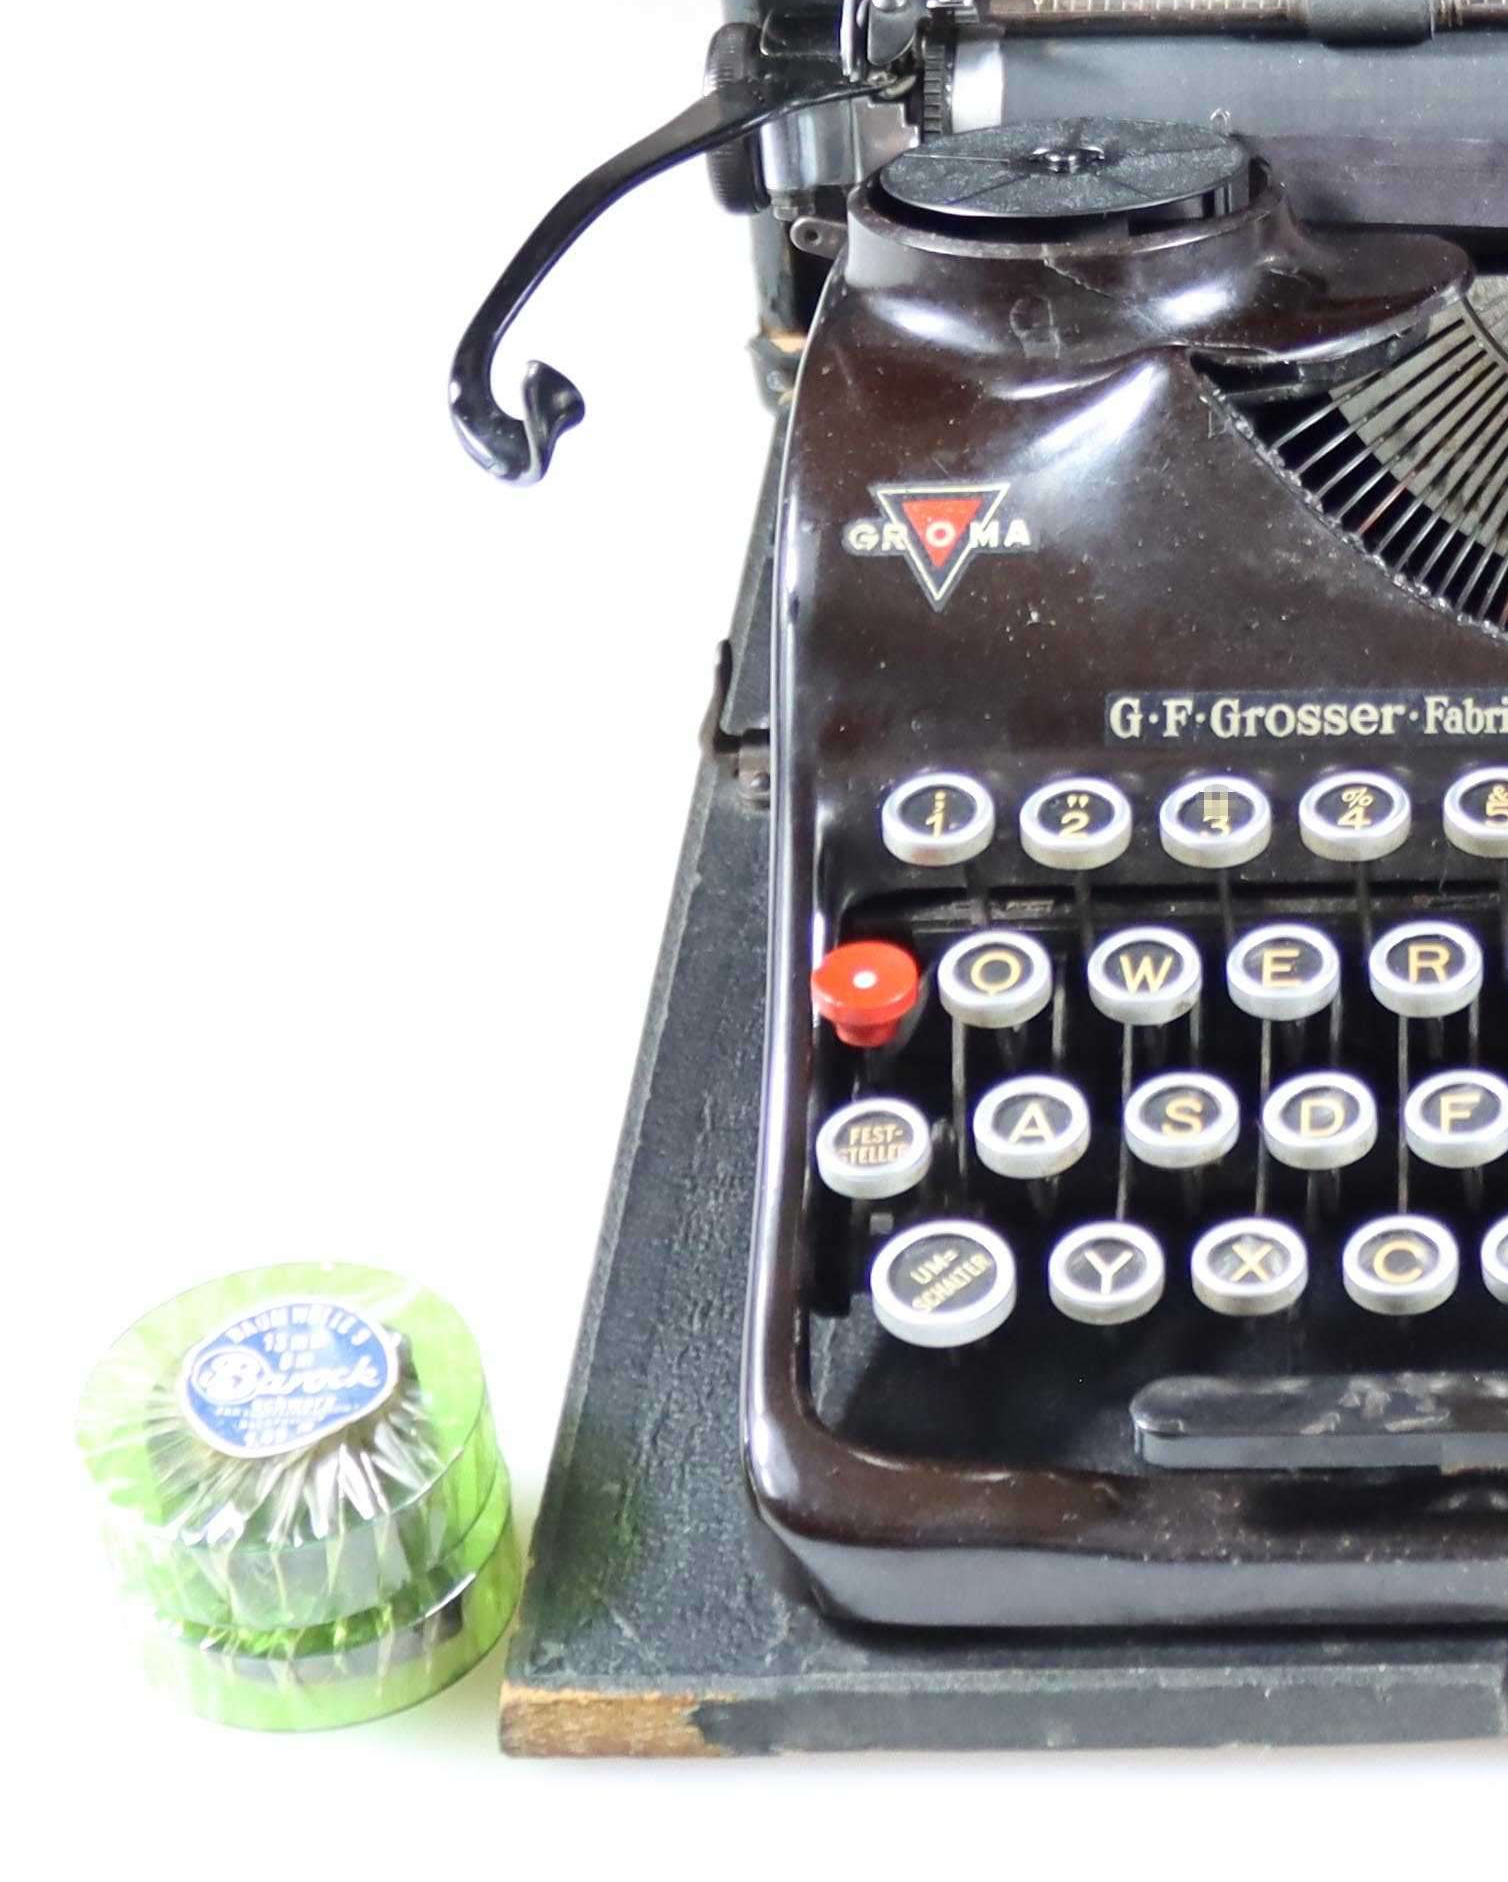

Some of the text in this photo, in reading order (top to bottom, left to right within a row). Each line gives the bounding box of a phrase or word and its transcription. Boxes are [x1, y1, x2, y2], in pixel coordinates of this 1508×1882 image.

[848, 518, 1032, 552] GROMA
[1342, 787, 1374, 806] %
[926, 812, 944, 838] 1
[1058, 812, 1091, 839] 2
[1337, 807, 1371, 830] 4
[1118, 952, 1173, 994] W
[1261, 948, 1301, 989] E
[1407, 943, 1452, 985] R
[1007, 1102, 1055, 1144] A
[1163, 1095, 1204, 1137] S
[1300, 1098, 1345, 1137] D
[1440, 1093, 1481, 1134] F
[1083, 1249, 1133, 1296] Y
[1231, 1242, 1272, 1283] X
[1373, 1240, 1426, 1284] C
[911, 1253, 993, 1313] SCHALTER
